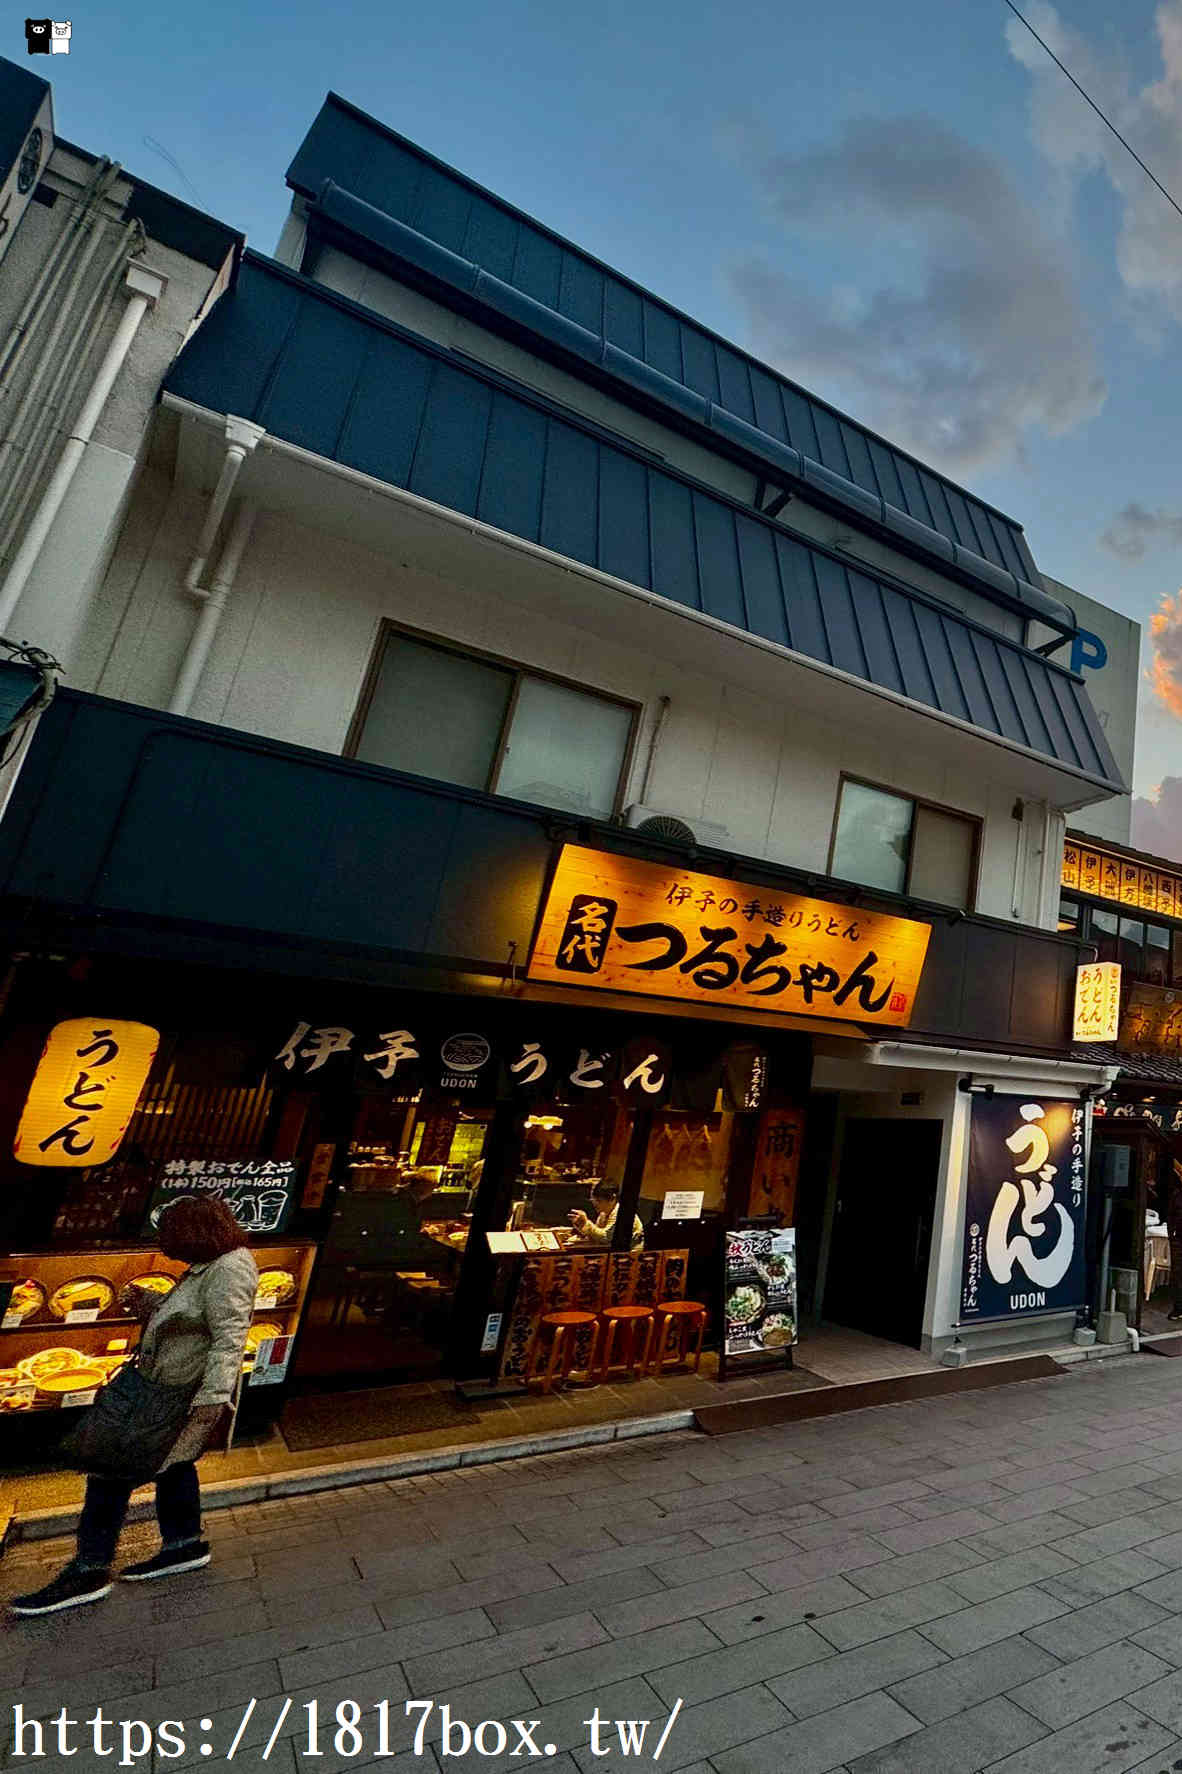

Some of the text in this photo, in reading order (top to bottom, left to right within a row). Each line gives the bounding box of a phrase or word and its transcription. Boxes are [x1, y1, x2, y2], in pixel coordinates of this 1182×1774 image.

[1070, 627, 1107, 675] P
[1064, 848, 1076, 884] 松山
[563, 901, 608, 975] 名代
[665, 882, 861, 942] 伊予の手造りうどん
[615, 922, 895, 1013] つるちゃん
[1089, 967, 1103, 1022] うどん
[1078, 970, 1091, 1023] おでん
[274, 1021, 421, 1080] 伊予
[510, 1042, 665, 1094] うどん
[38, 1029, 119, 1156] うどん
[440, 1077, 477, 1089] UDON
[165, 1159, 295, 1176] 特製おでん全品
[1071, 1108, 1084, 1208] 伊予の手造り
[986, 1103, 1075, 1289] うどん
[1010, 1291, 1046, 1310] UDON
